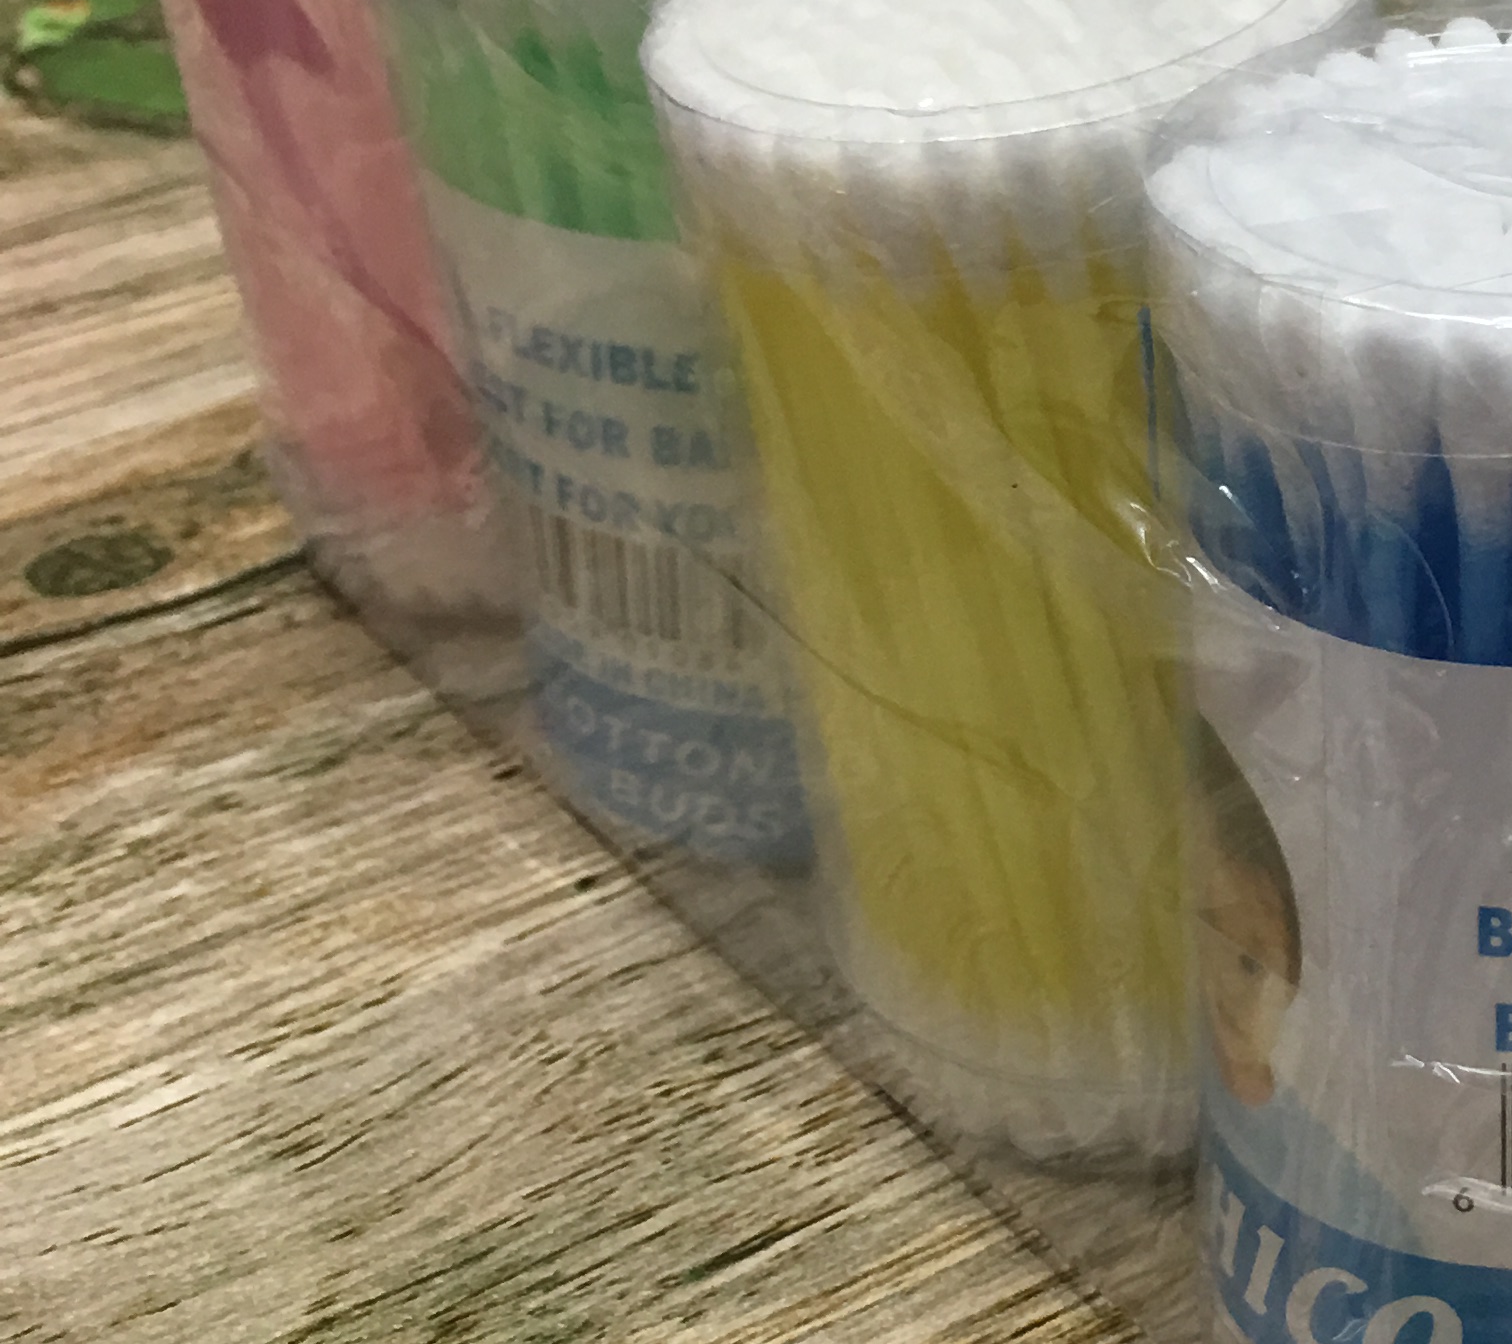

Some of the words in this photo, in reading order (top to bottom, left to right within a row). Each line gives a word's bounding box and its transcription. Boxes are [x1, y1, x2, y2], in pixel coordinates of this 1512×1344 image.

[486, 304, 698, 397] FLEXIBLE
[543, 400, 632, 459] FOR
[1452, 1186, 1475, 1214] 6
